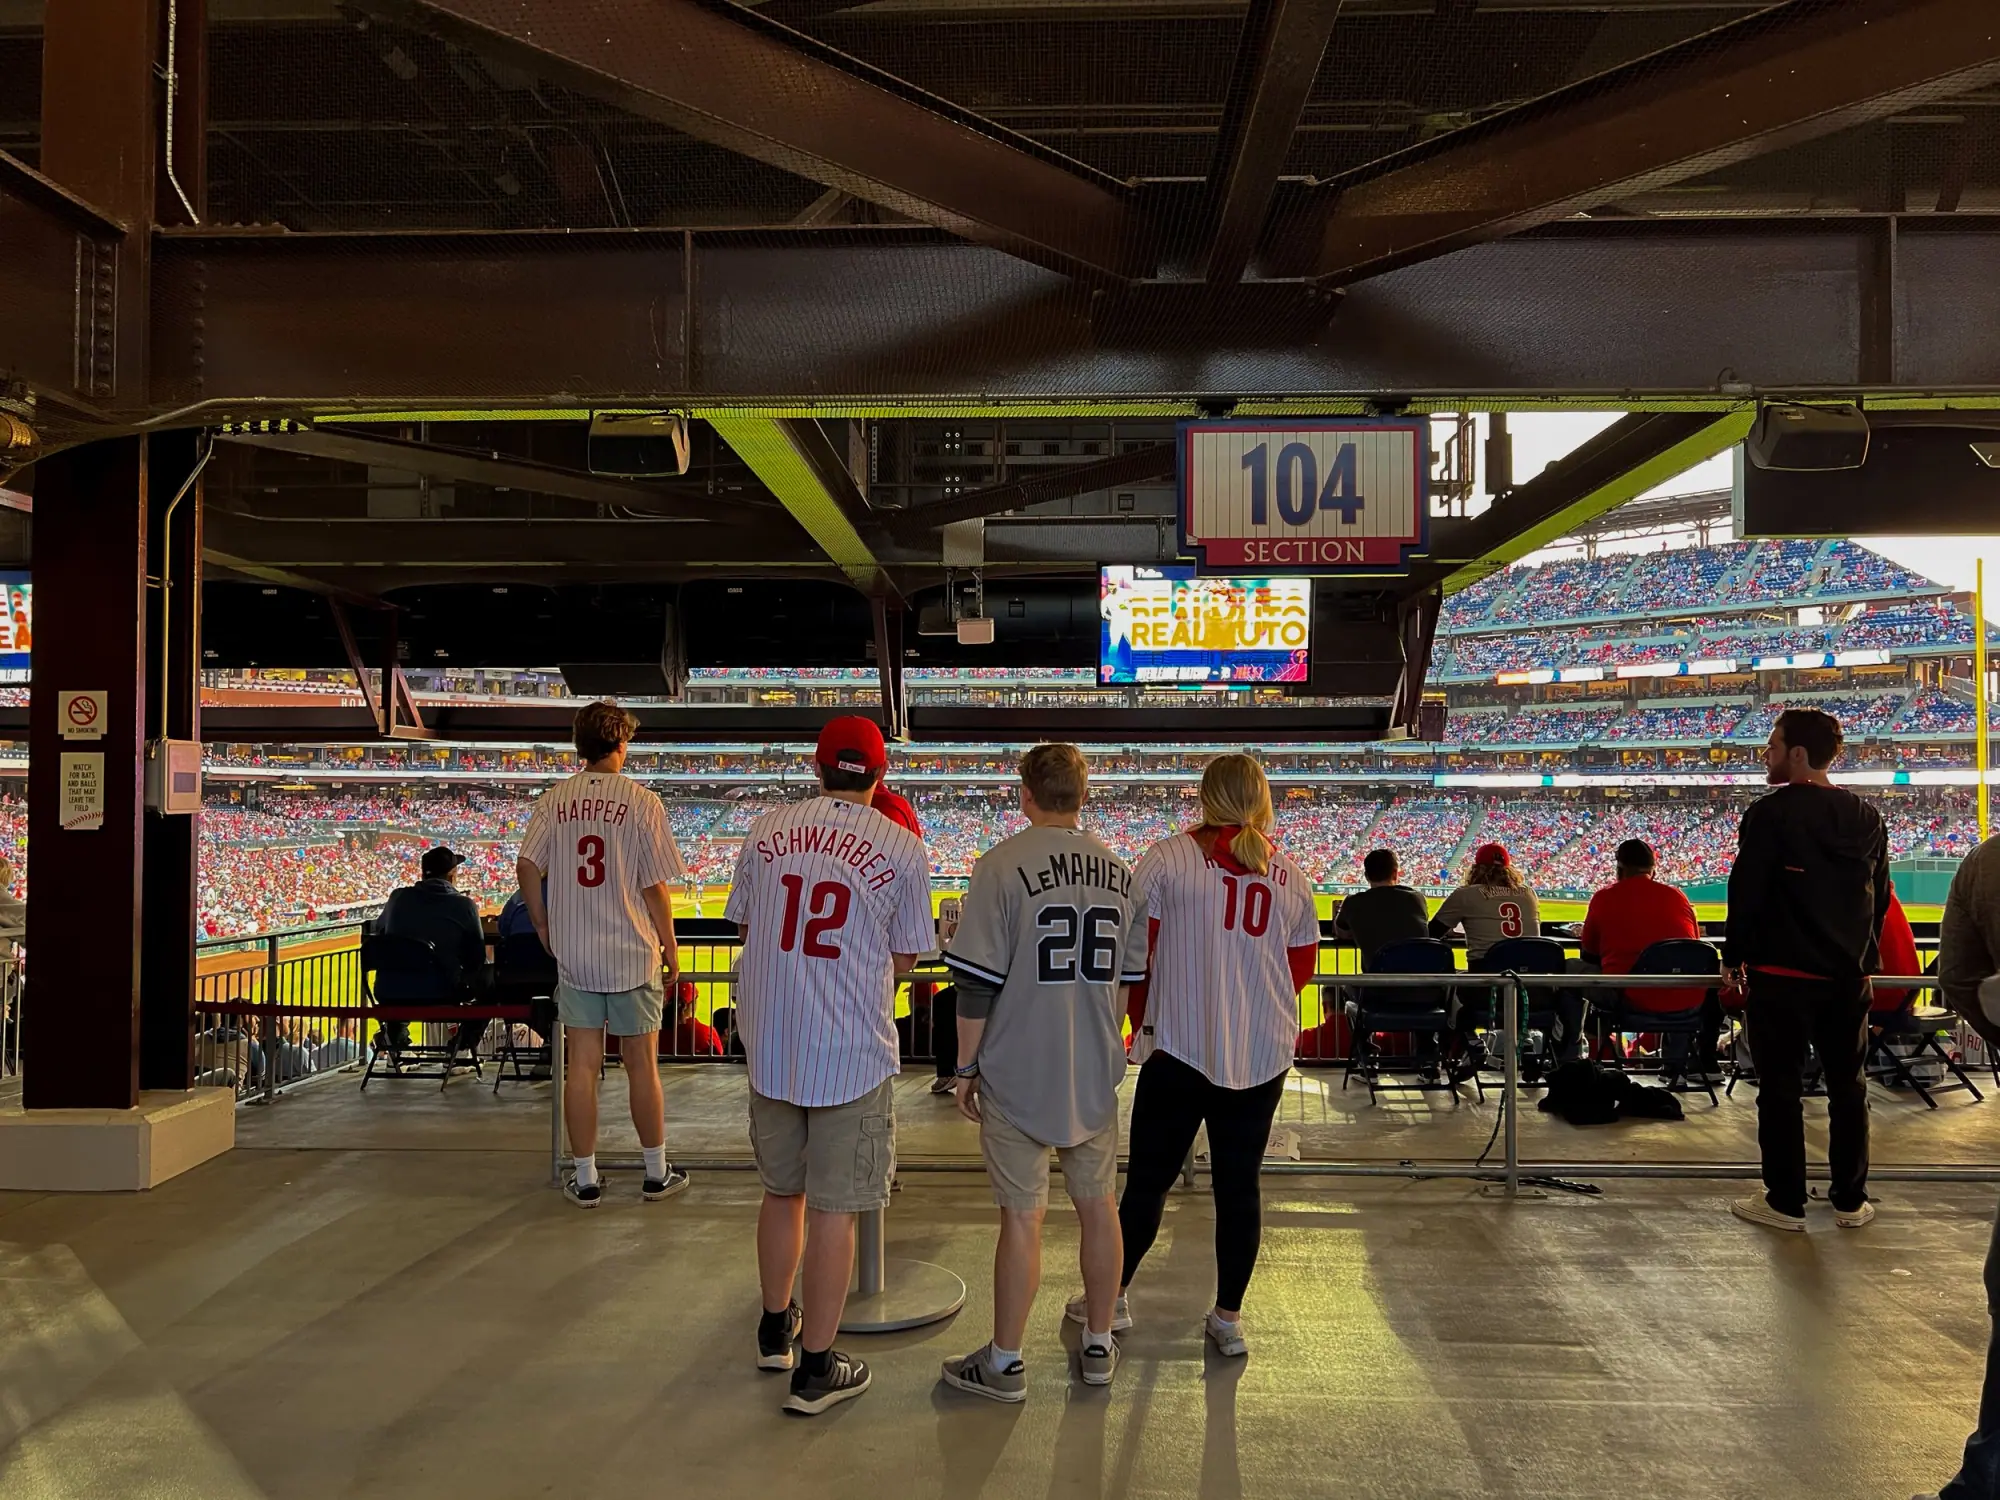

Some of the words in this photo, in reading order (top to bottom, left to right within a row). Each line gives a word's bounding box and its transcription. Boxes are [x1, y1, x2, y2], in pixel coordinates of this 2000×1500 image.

[1241, 442, 1365, 526] 104
[1244, 541, 1365, 562] SECTION
[557, 799, 628, 826] HARPER
[577, 835, 605, 888] 3
[757, 826, 895, 891] SCHWARBER
[780, 873, 851, 960] 12
[1222, 876, 1272, 937] 10
[1499, 902, 1523, 938] 3
[1036, 904, 1121, 984] 26
